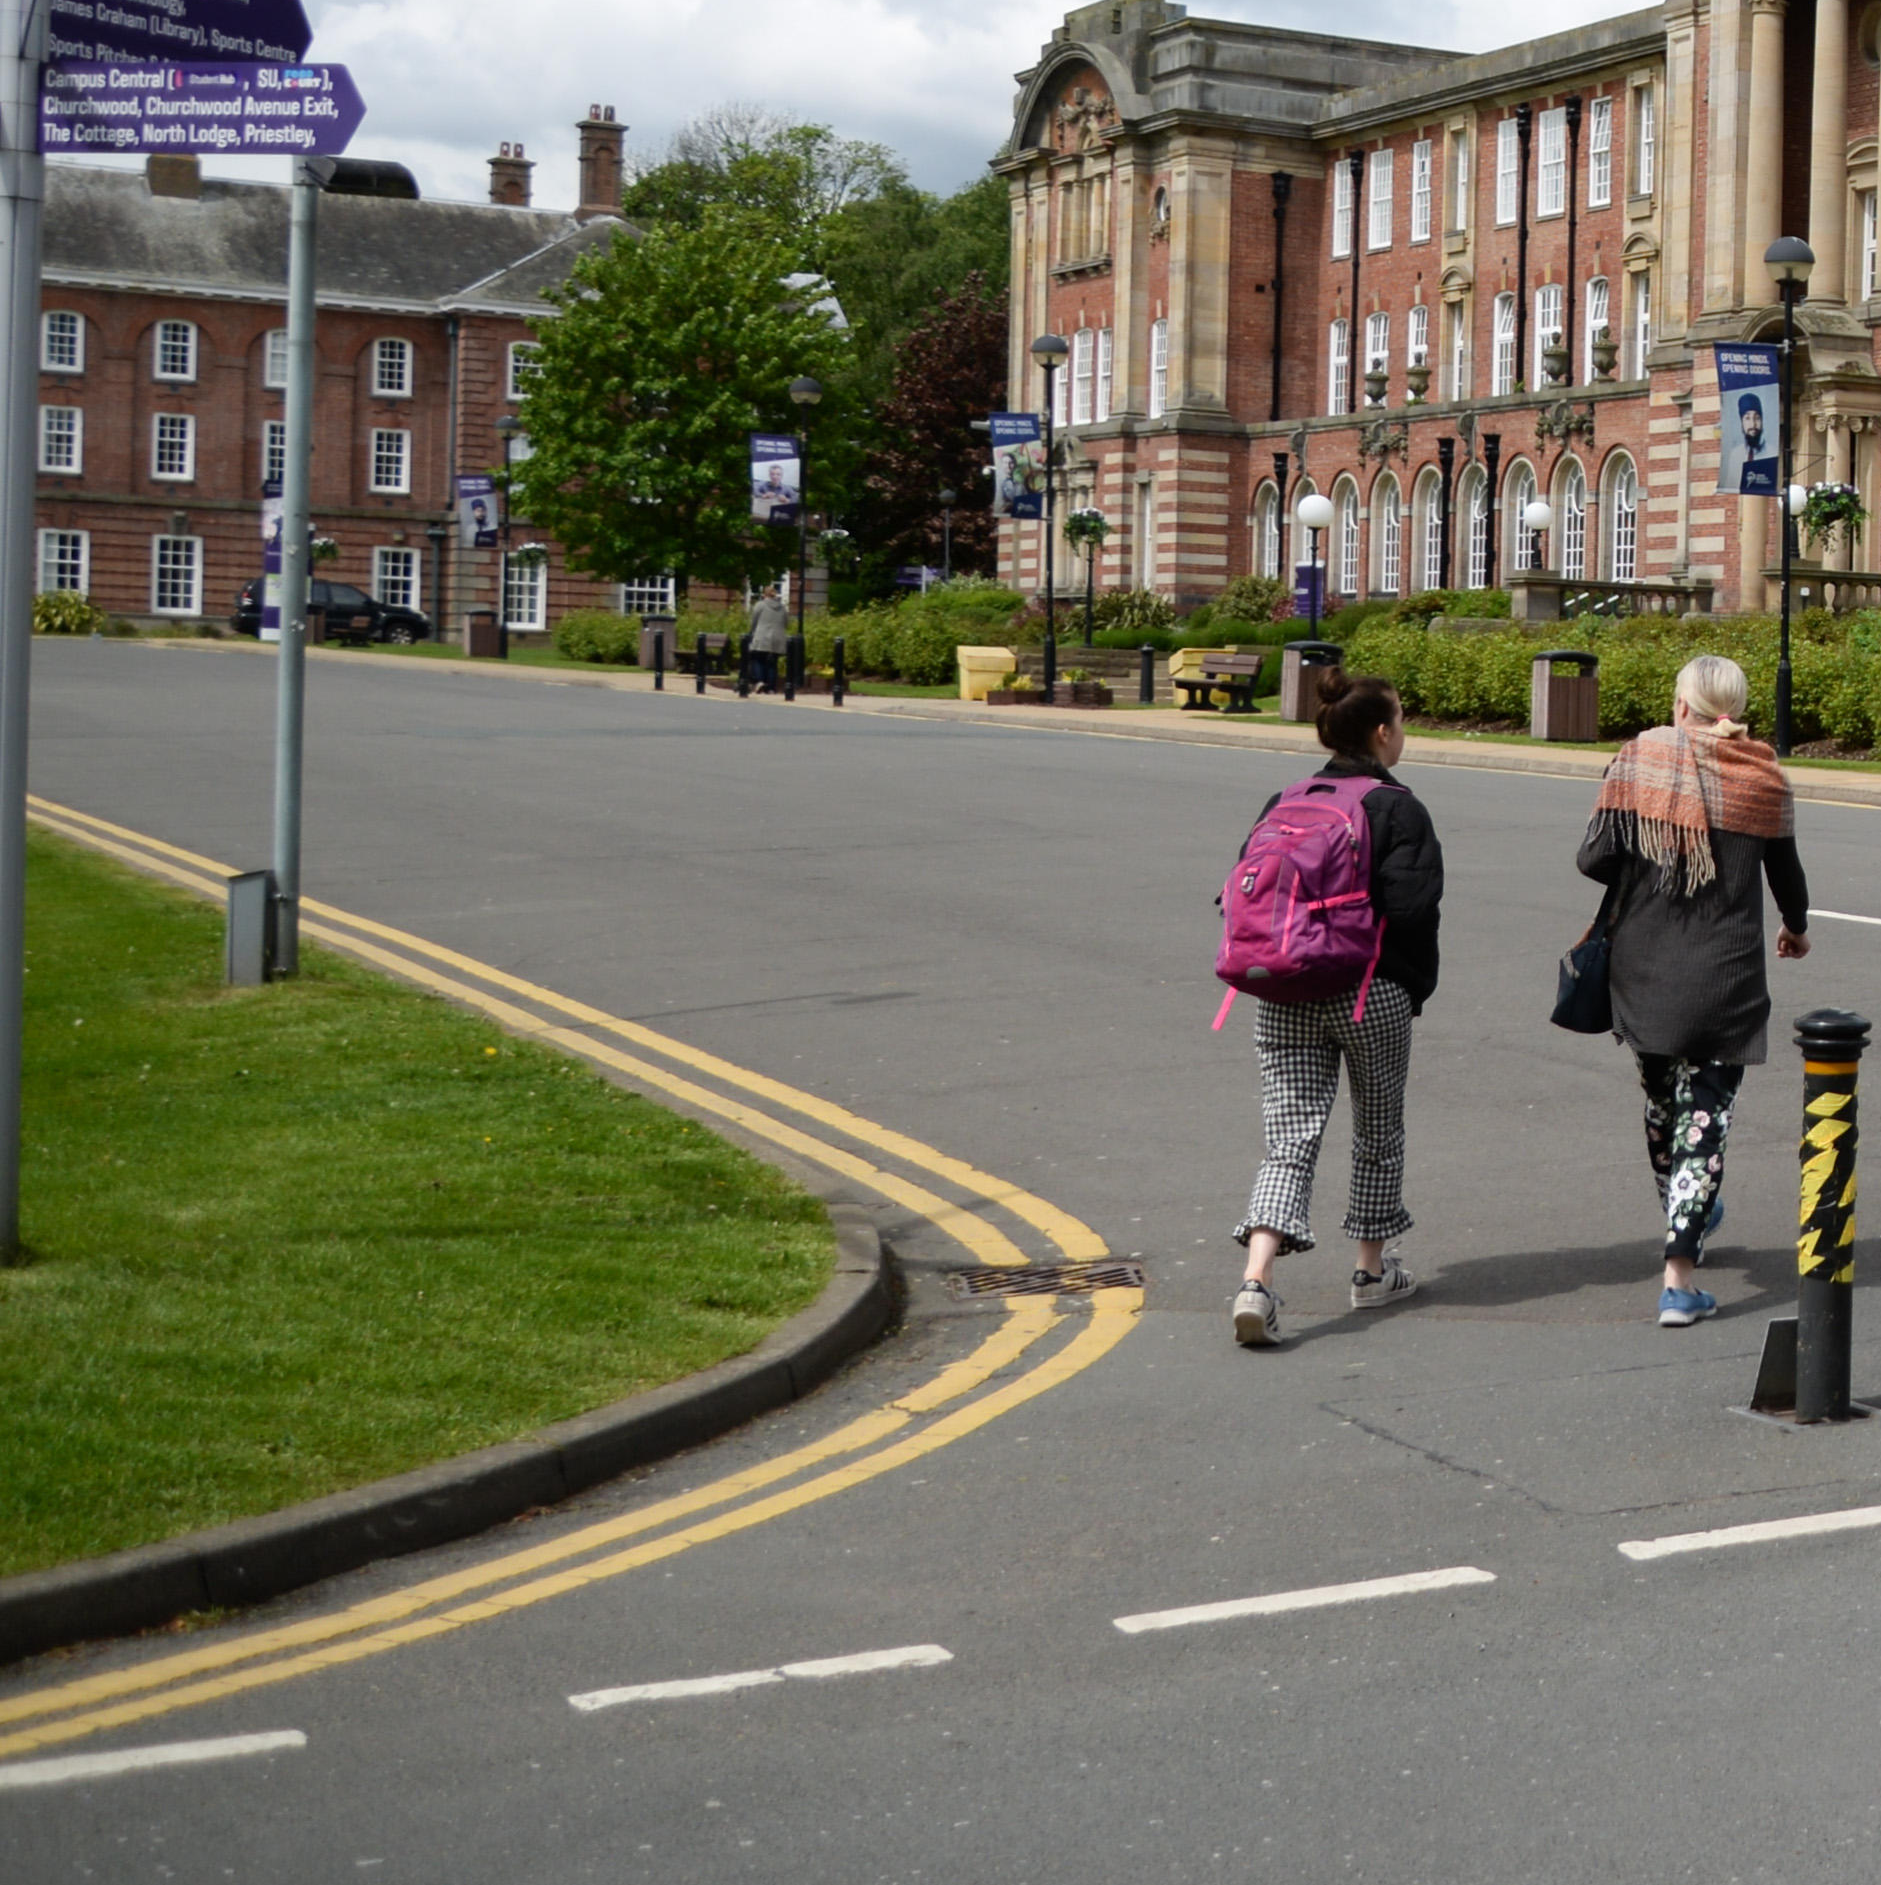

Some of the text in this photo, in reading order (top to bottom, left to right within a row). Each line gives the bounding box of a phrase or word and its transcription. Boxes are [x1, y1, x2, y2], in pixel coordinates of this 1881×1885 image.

[96, 3, 147, 30] Graham
[211, 28, 253, 53] Sports
[255, 39, 297, 64] Centre
[49, 33, 93, 60] Sports
[45, 69, 106, 92] Campus
[109, 69, 165, 88] Central
[44, 96, 339, 119] Churchwood, Churchwood Avenue Exit,
[44, 123, 316, 148] The Cottage, North Lodge, Priestley,
